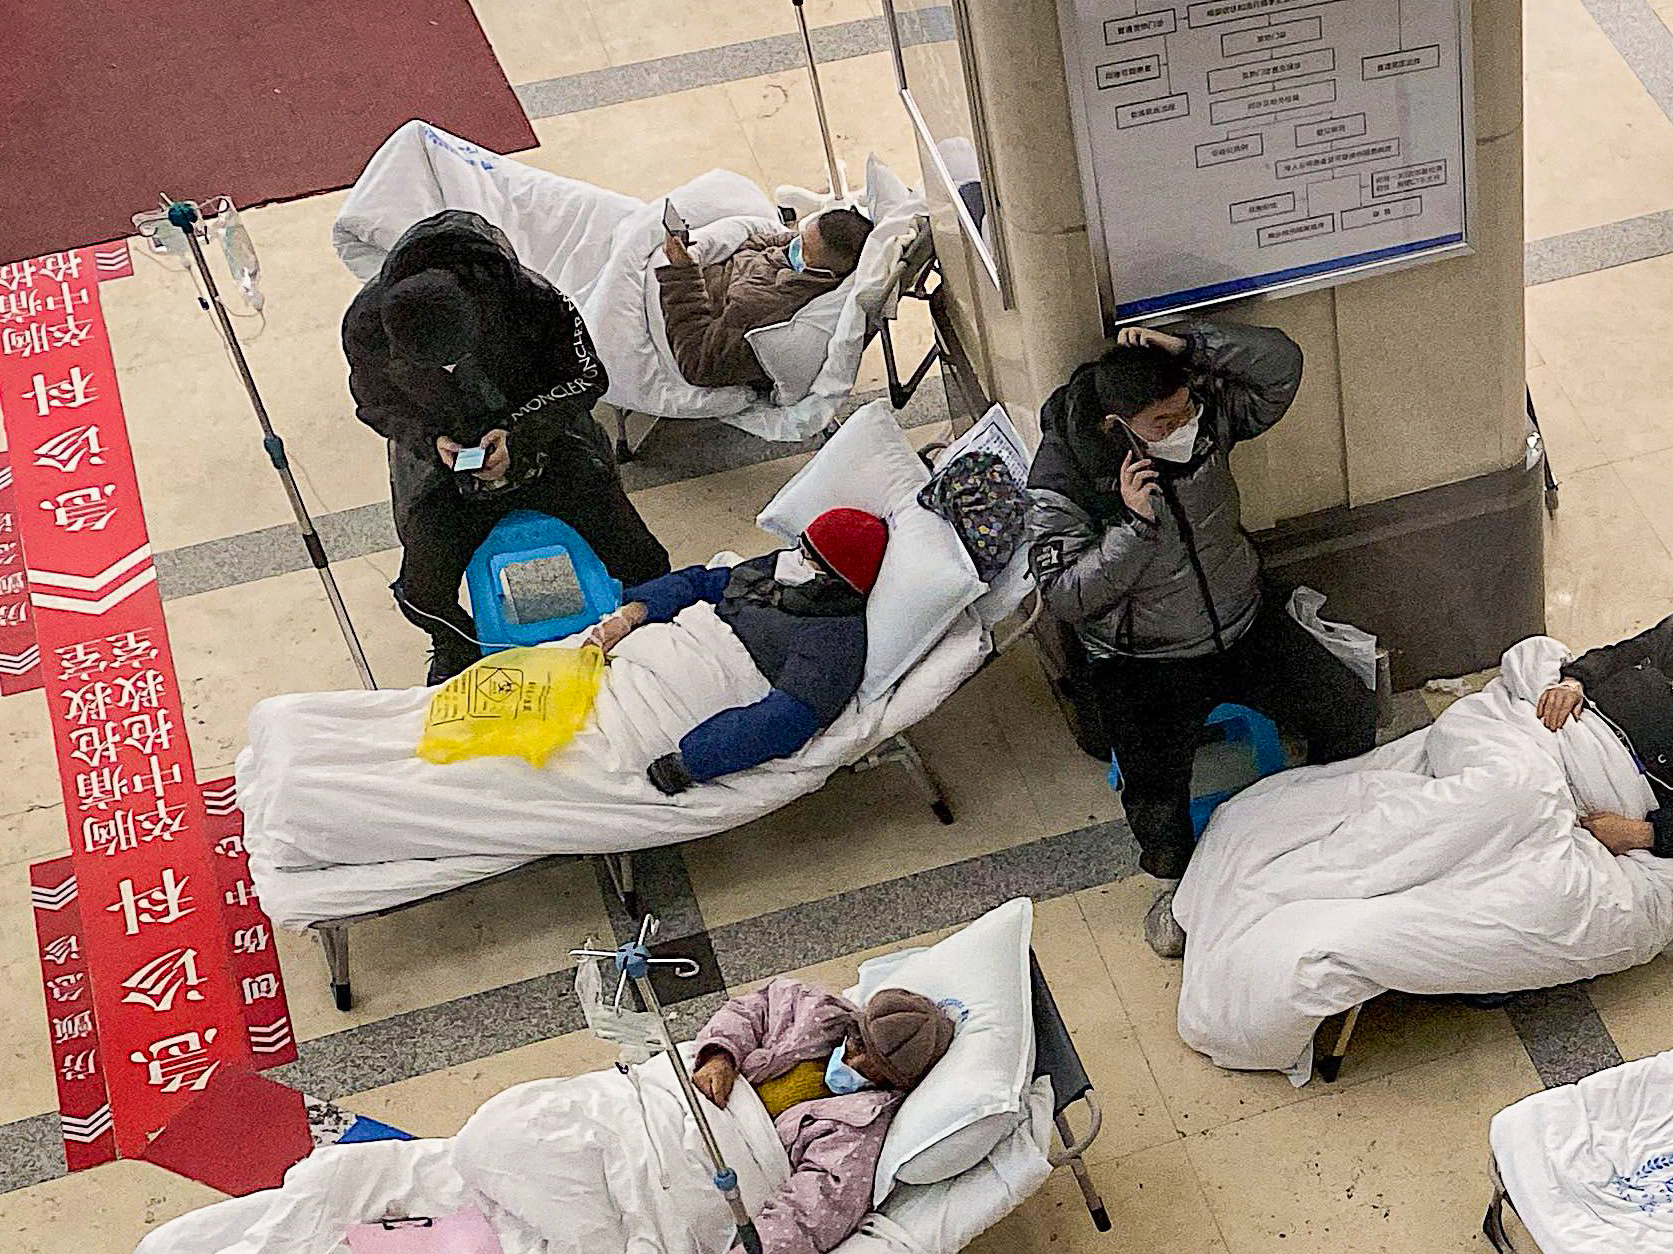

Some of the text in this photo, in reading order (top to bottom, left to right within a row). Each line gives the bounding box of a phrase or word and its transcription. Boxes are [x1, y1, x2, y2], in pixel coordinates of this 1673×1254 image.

[21, 366, 119, 533] 急诊科
[511, 377, 594, 422] MONCLER
[53, 640, 143, 856] 胸痛抢救室
[104, 626, 190, 845] 卒中抢救室
[105, 868, 221, 1095] 急诊科
[214, 836, 279, 1005] 创伤中心
